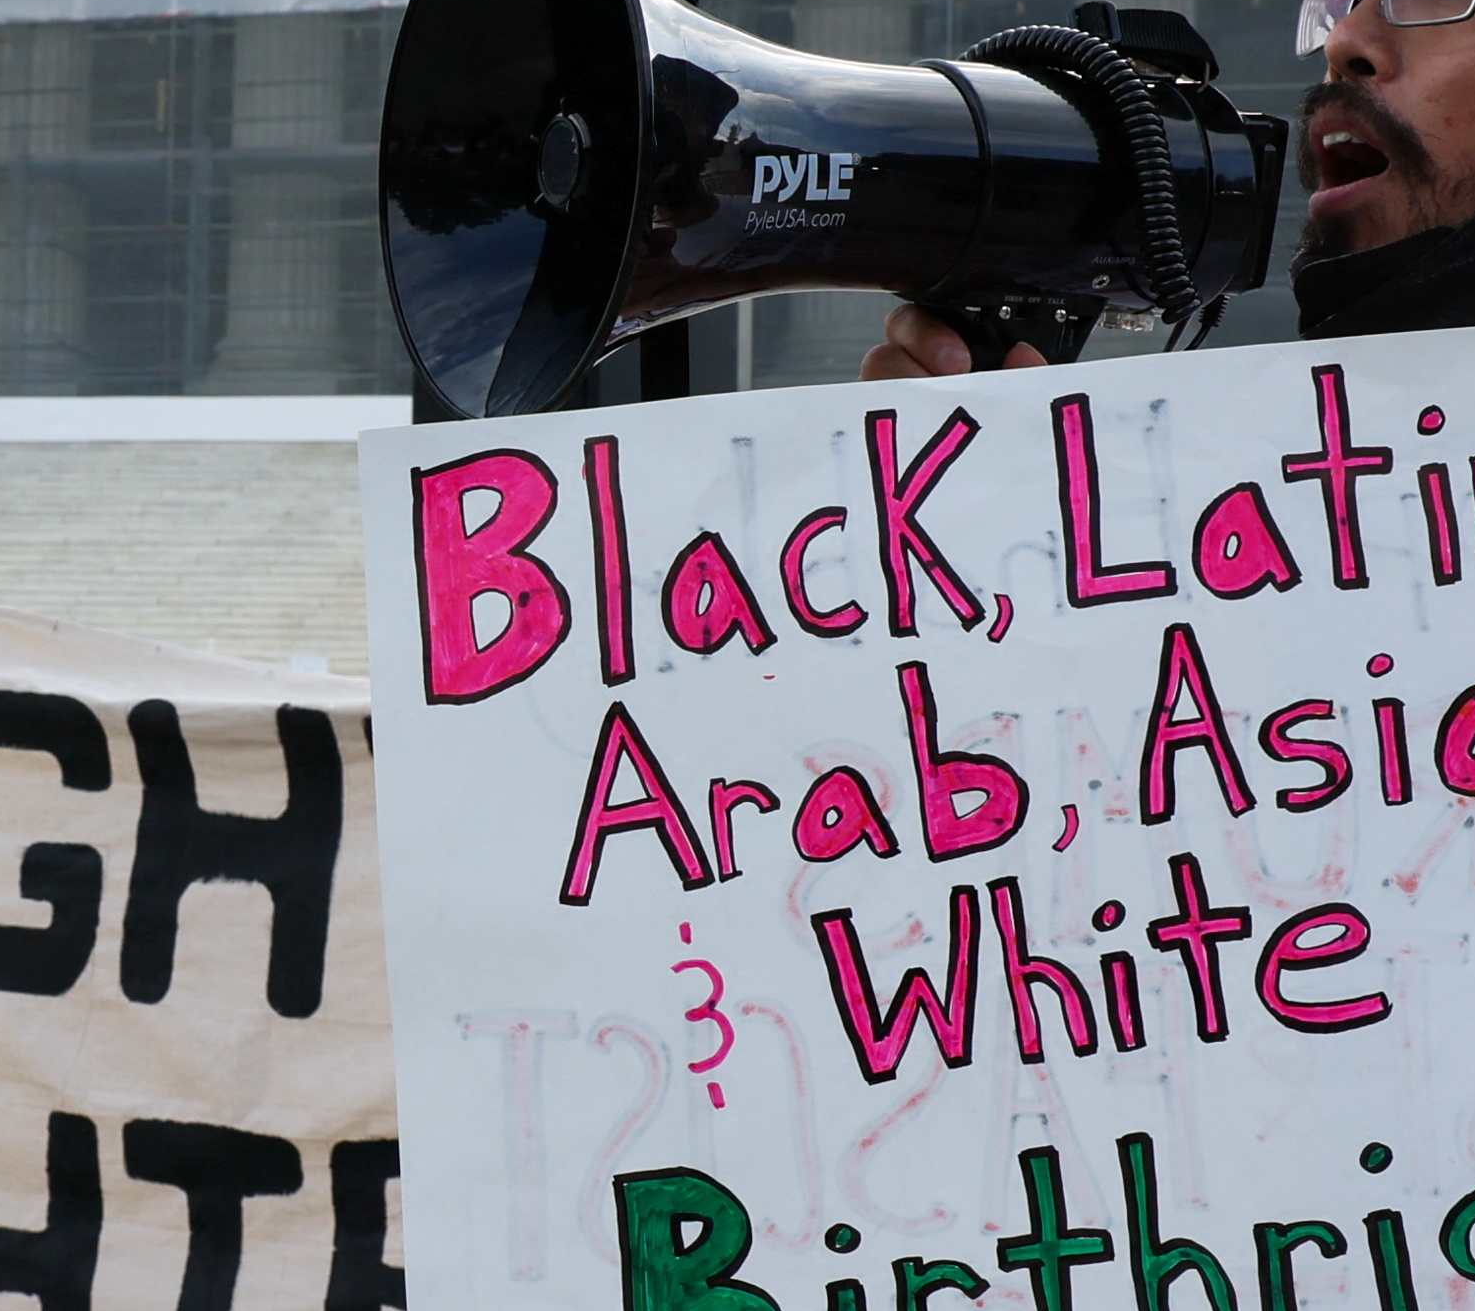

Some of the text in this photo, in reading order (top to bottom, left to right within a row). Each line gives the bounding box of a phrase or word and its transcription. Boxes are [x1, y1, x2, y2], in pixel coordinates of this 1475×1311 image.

[745, 208, 846, 236] PyleUSA.com
[1003, 295, 1066, 305] SIREN OFF TALK
[558, 661, 1081, 907] Arab,
[810, 851, 1394, 1086] White
